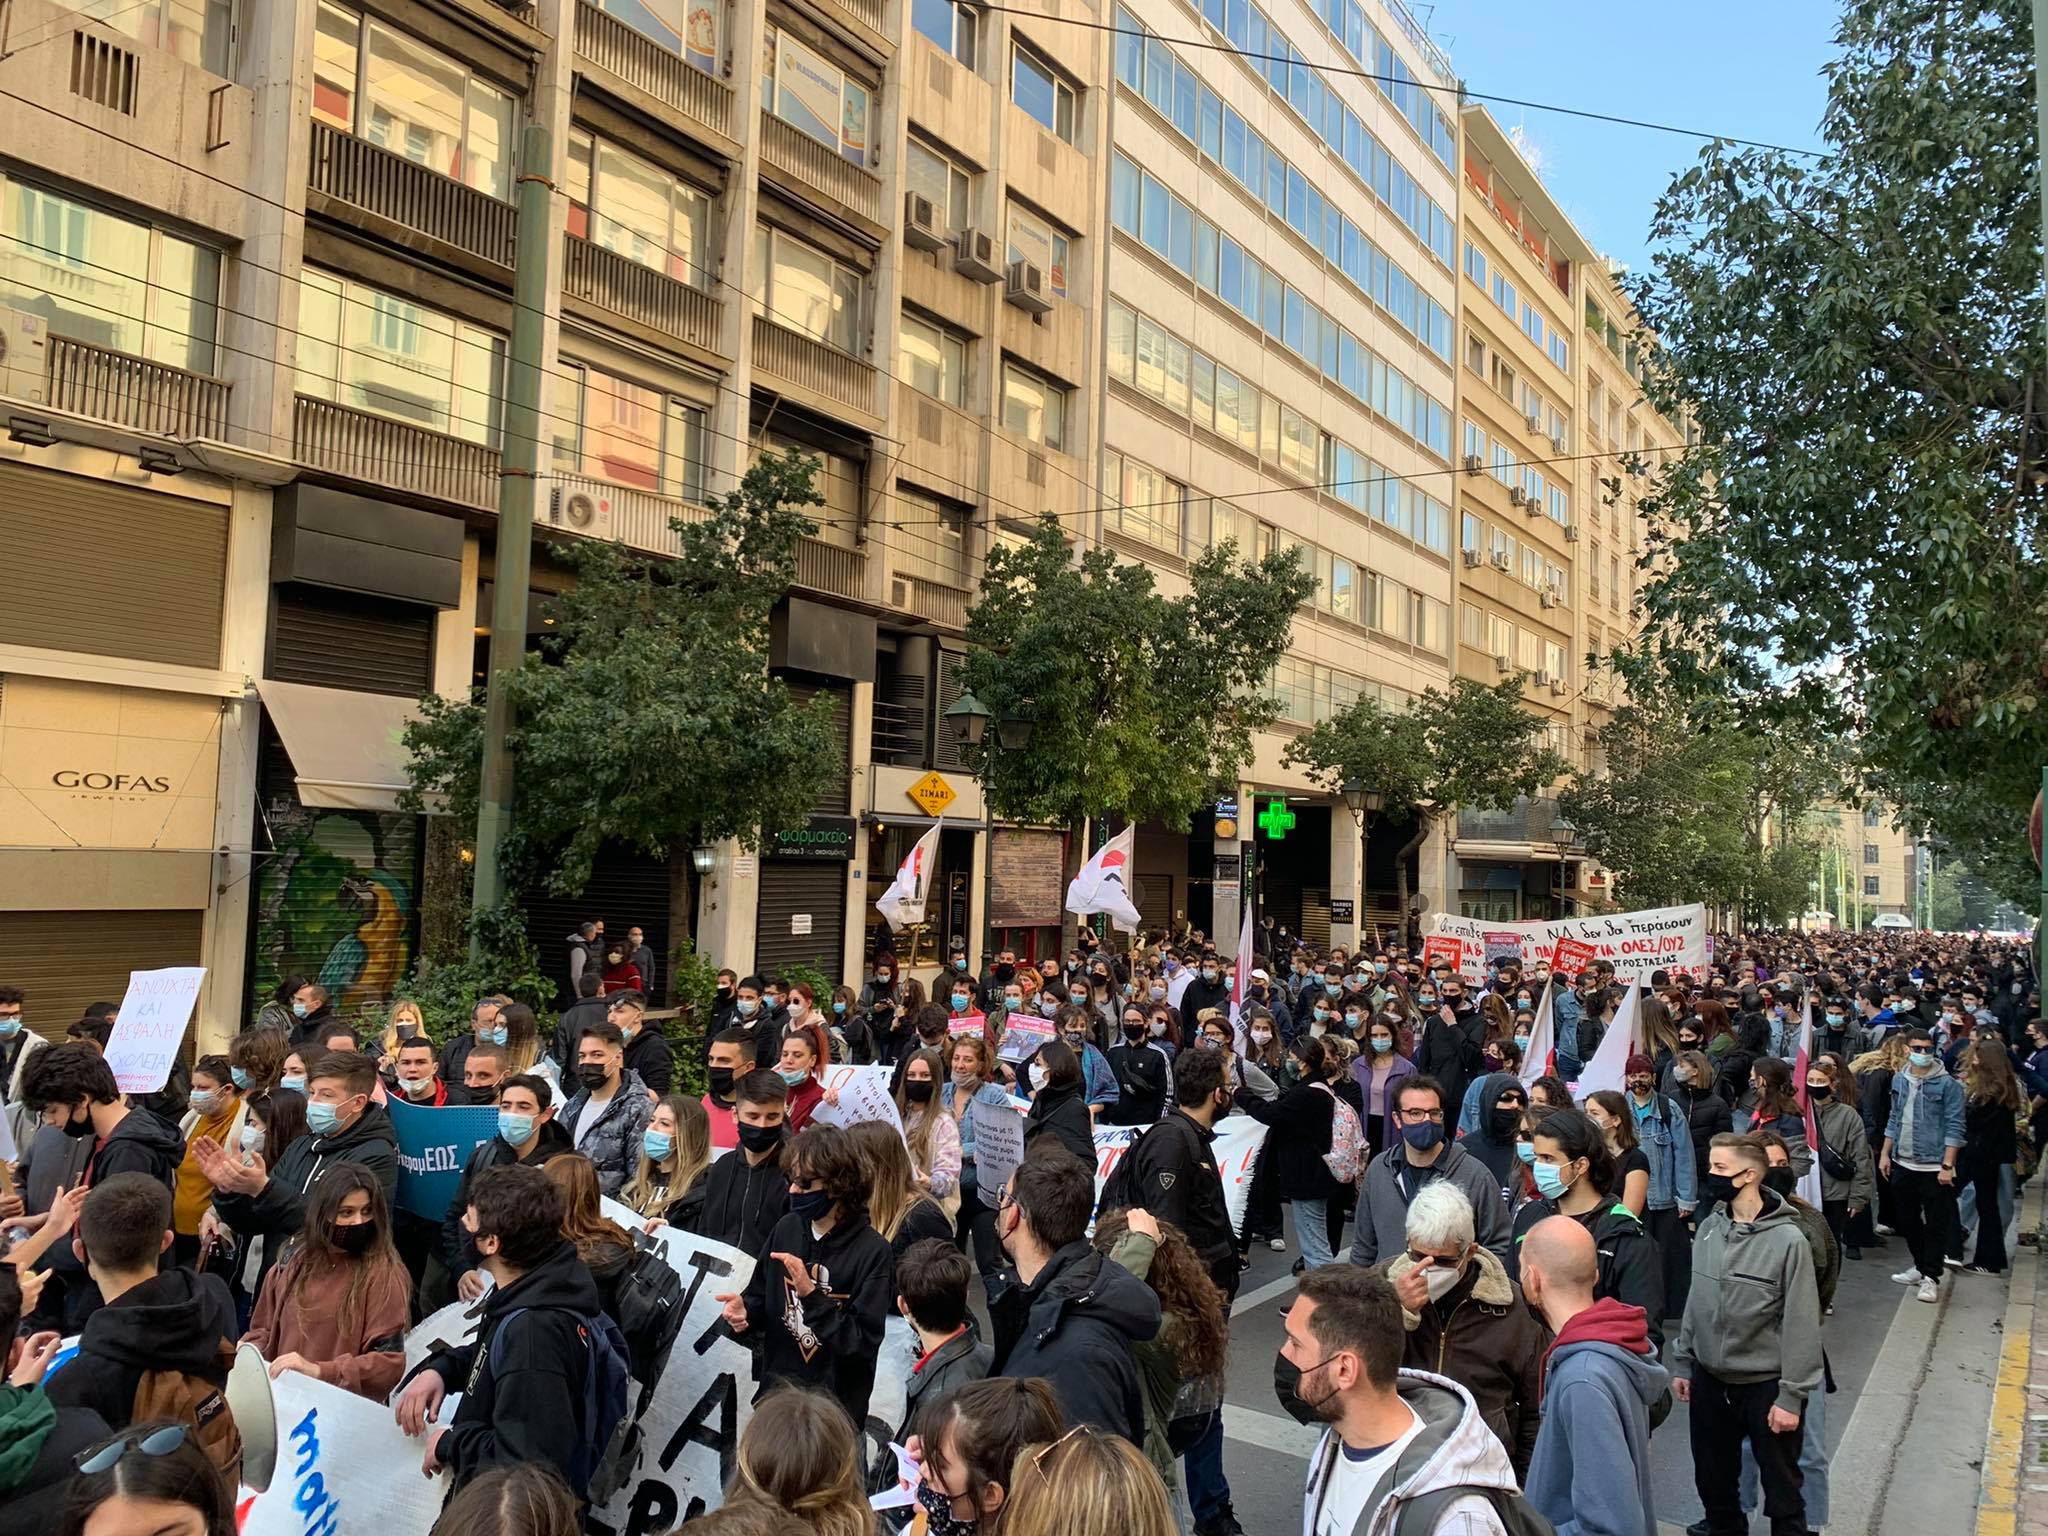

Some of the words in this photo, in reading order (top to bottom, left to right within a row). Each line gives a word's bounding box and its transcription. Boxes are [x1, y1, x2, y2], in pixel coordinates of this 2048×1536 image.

[52, 770, 170, 794] GOFAS
[71, 794, 147, 802] JEWELRY
[1580, 922, 1602, 939] δεν
[1604, 919, 1624, 937] θα
[1630, 915, 1693, 937] περάσουν
[1621, 935, 1686, 956] ΟΛΕΣ/ΟΥΣ
[1613, 954, 1678, 968] ΠΡΟΣΤΑΣΙΑΣ
[136, 1002, 162, 1017] ΚΑΙ
